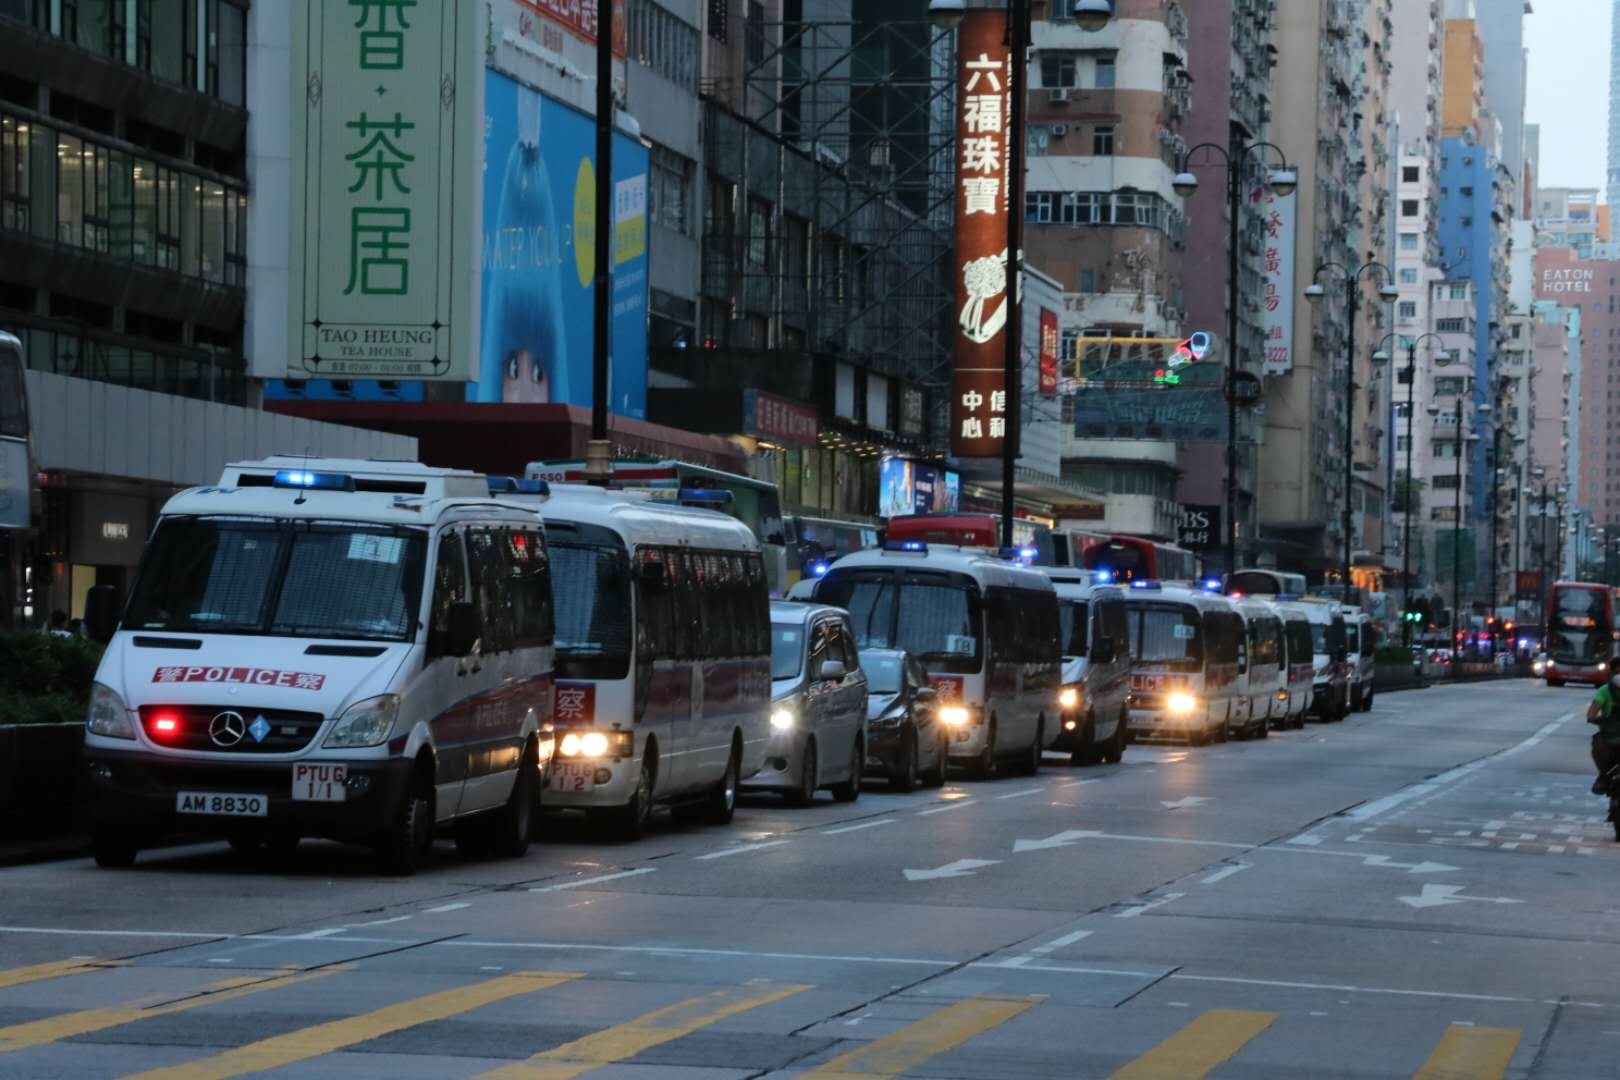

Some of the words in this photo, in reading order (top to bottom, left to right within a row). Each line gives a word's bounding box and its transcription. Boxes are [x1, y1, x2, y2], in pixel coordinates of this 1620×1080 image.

[962, 53, 1002, 215] 六福珠寶
[1543, 269, 1593, 280] EATON
[1543, 281, 1592, 292] HOTEL
[321, 329, 357, 343] TAO
[364, 330, 432, 344] HEUNG
[341, 346, 365, 356] TEA
[369, 346, 413, 357] HOUSE
[558, 688, 586, 718] 察
[307, 782, 333, 799] 1/1
[558, 776, 585, 791] 1/2
[182, 796, 206, 810] AM
[211, 796, 261, 813] 8830
